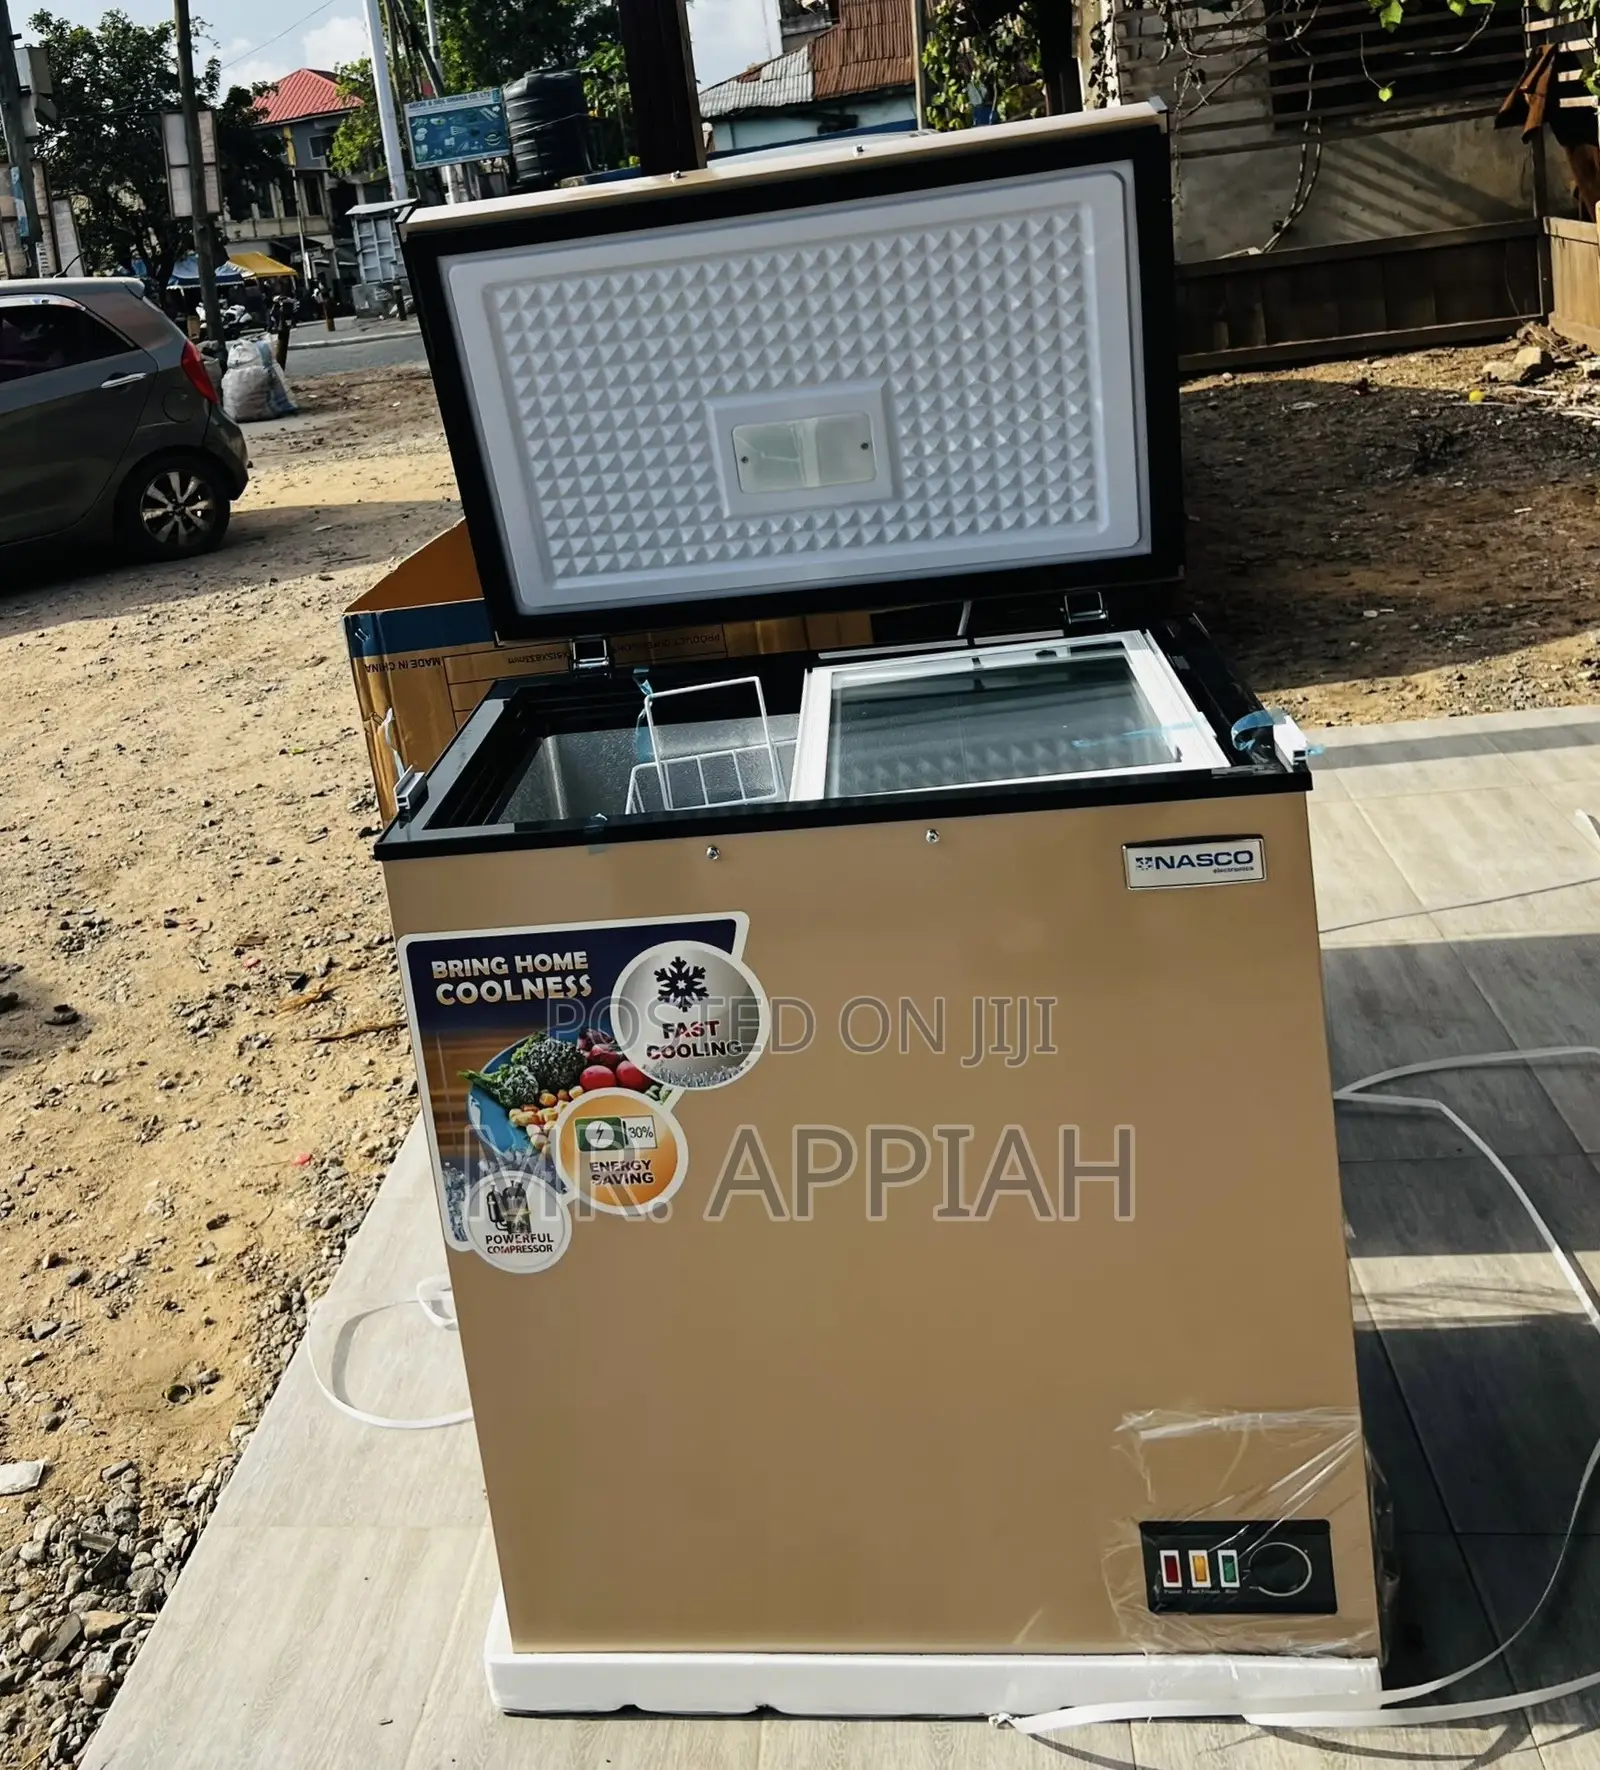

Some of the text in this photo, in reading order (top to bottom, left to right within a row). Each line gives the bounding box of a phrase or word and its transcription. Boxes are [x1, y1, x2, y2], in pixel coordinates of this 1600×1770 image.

[364, 656, 442, 674] MADE IN CHINA
[1155, 849, 1254, 870] NASCO
[430, 950, 589, 980] BRING HOME
[435, 973, 592, 1006] COOLNESS
[661, 1019, 721, 1040] FAST
[645, 1039, 743, 1061] COOLING
[627, 1124, 654, 1140] 30%
[589, 1159, 653, 1175] ENERGY
[591, 1171, 655, 1186] SAVING
[485, 1232, 555, 1246] POWERFUL
[486, 1243, 554, 1255] COMPRESSOR
